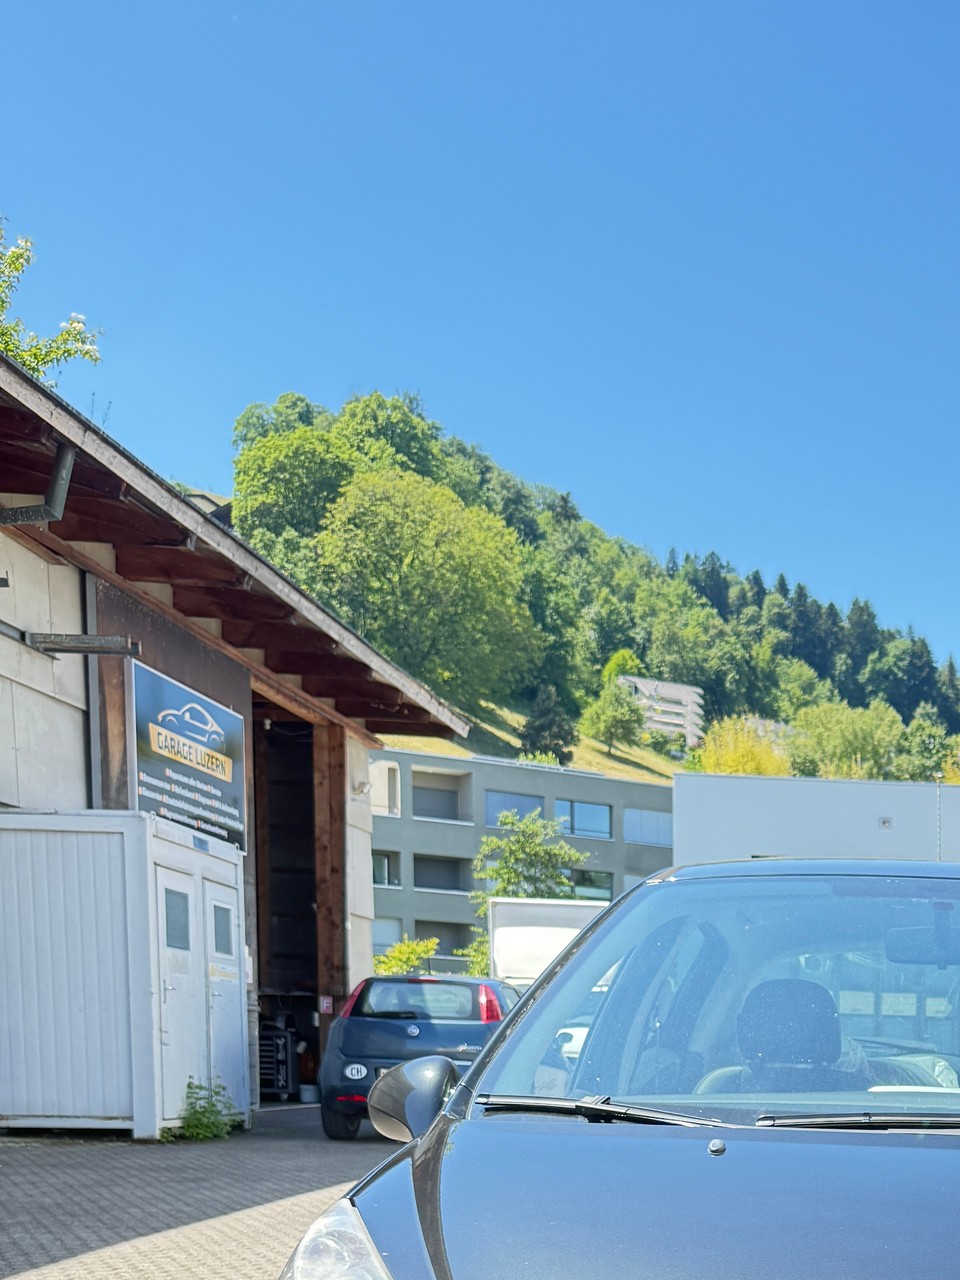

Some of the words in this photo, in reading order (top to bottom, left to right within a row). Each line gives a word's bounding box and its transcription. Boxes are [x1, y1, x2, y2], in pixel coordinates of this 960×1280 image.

[157, 732, 193, 762] GARAGE
[196, 746, 227, 777] LUZERN
[350, 1067, 363, 1077] CH
